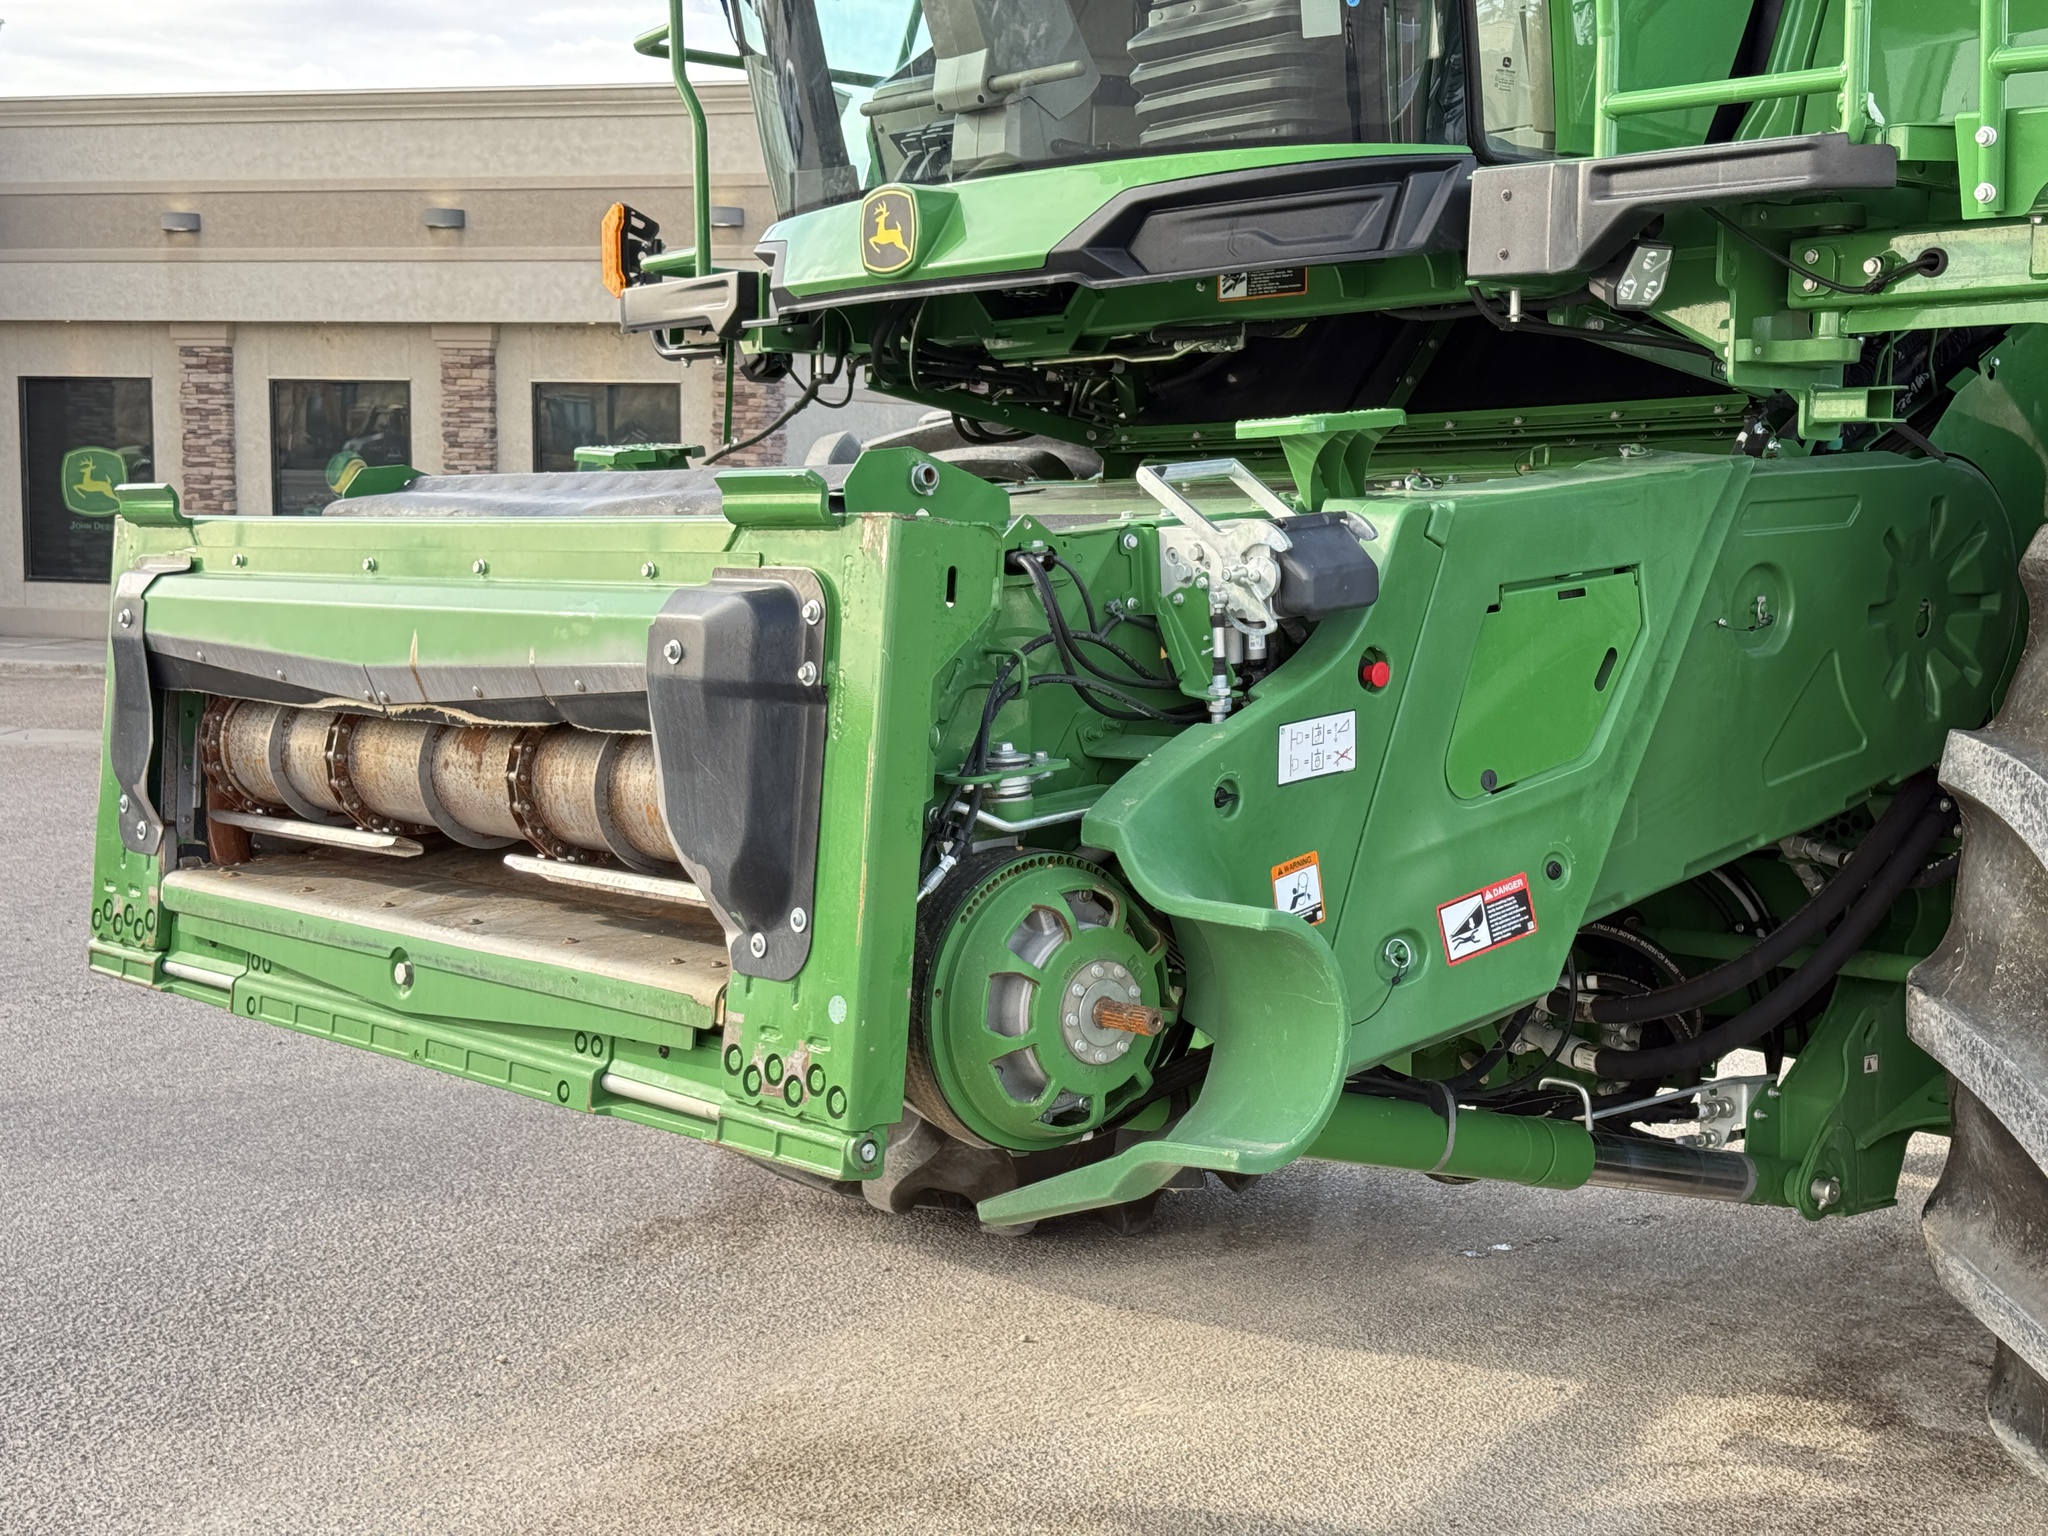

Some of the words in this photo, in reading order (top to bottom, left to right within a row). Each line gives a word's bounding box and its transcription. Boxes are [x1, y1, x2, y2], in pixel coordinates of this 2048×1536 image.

[93, 521, 113, 531] DEE
[1284, 856, 1312, 872] WARNING
[1492, 879, 1523, 897] DANGER
[1592, 923, 1611, 932] ITALY
[1618, 930, 1637, 942] MADE
